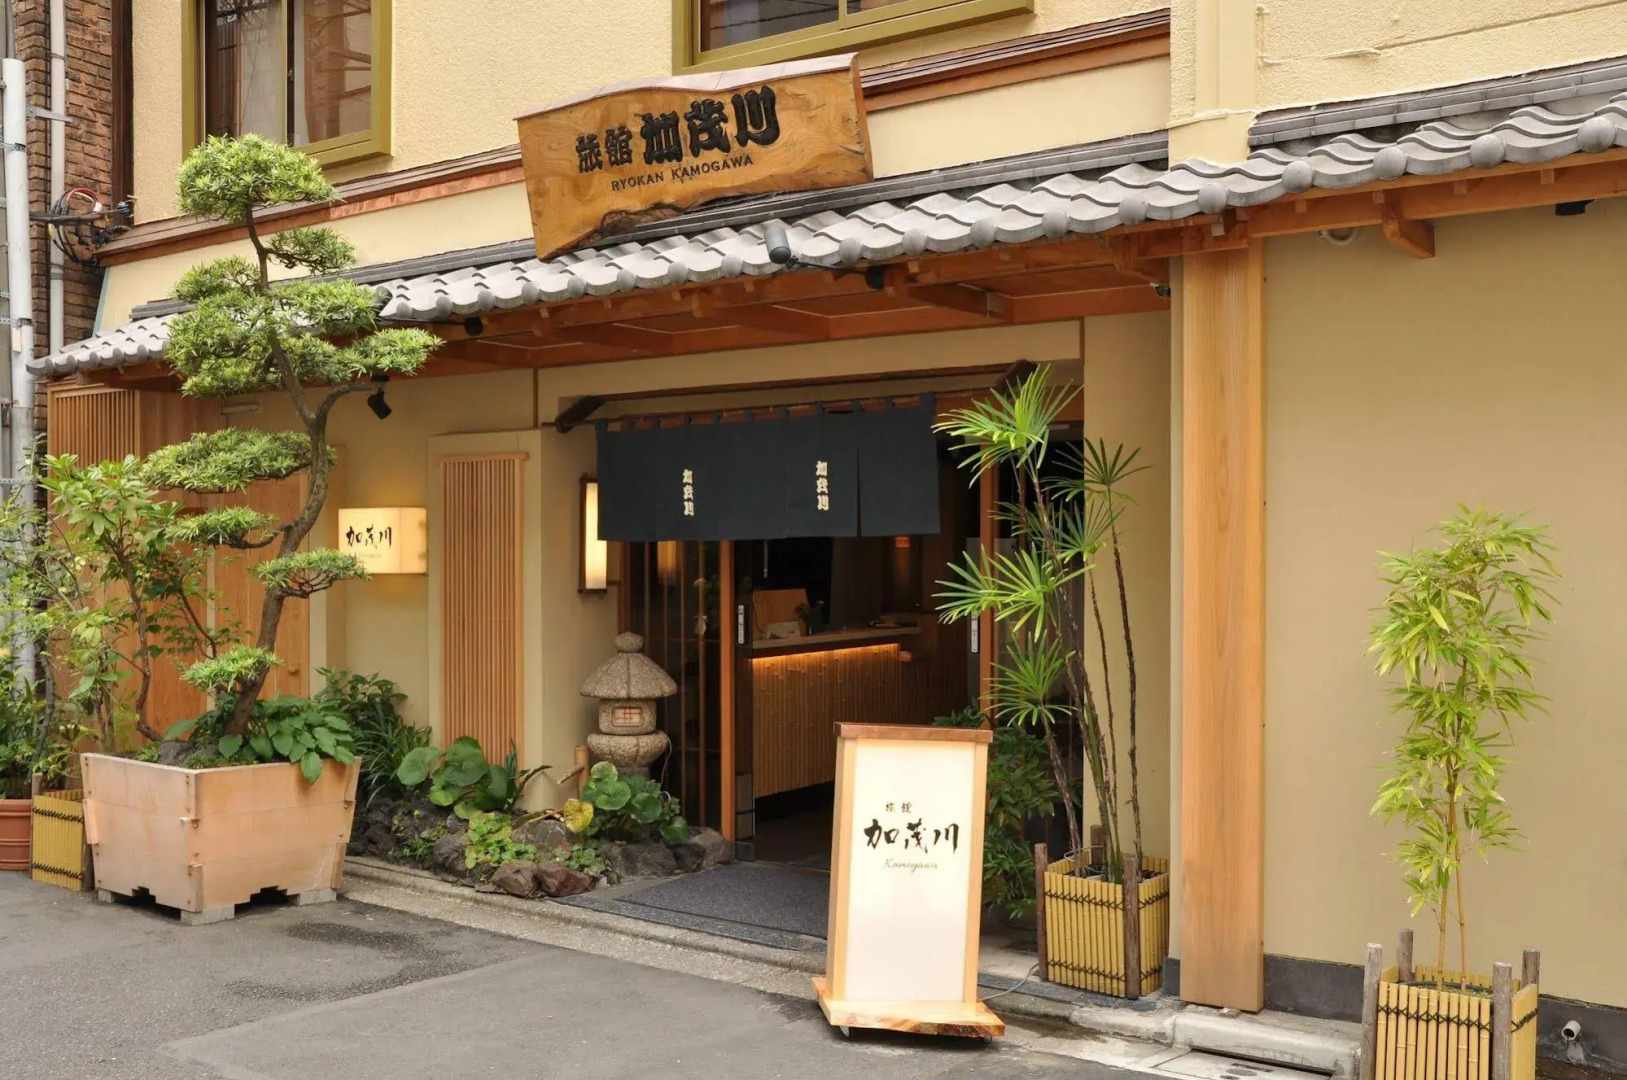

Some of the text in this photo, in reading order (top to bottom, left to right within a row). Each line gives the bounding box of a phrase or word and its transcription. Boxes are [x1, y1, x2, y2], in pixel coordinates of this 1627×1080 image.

[611, 155, 753, 191] RYOKAN KAMOGAWA
[345, 523, 392, 550] 加茂川
[863, 818, 960, 854] 加茂川
[882, 858, 938, 873] Kamogawa
